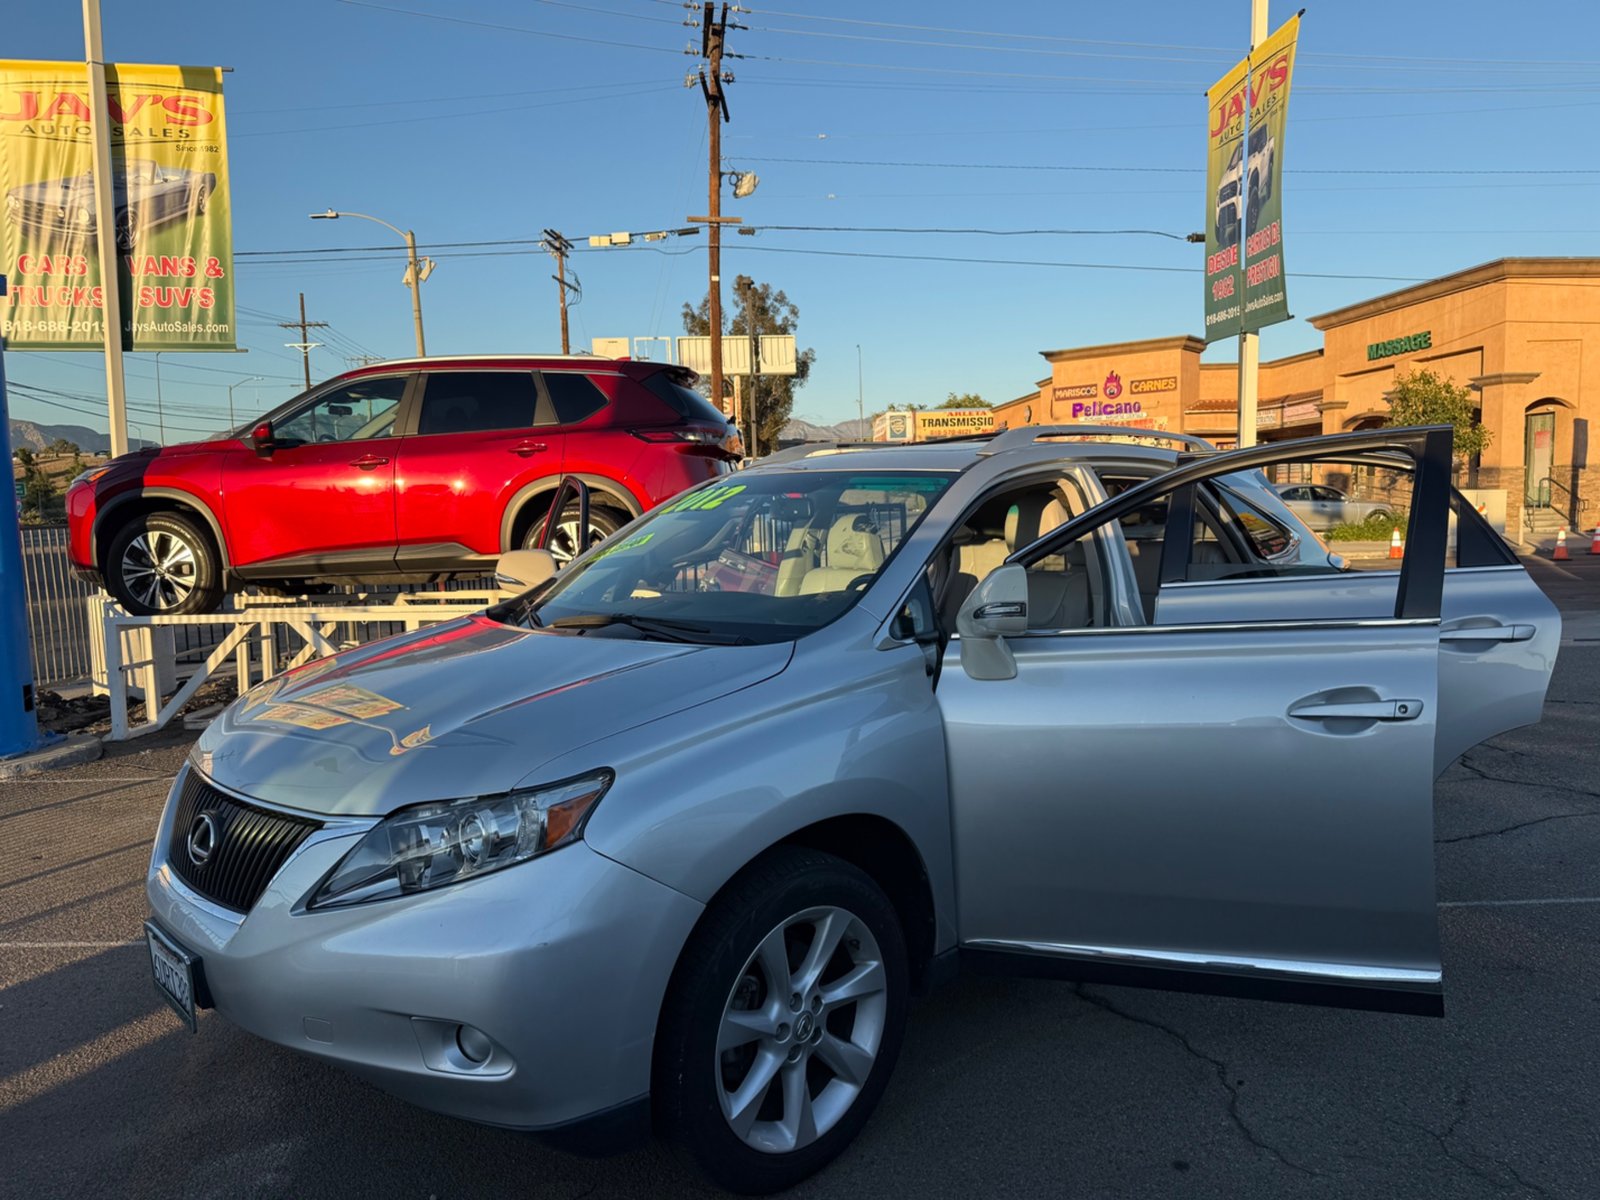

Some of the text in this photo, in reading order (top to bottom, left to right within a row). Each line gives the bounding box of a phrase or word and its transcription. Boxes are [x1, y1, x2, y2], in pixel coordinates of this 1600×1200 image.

[20, 124, 191, 139] AUTO SALES
[17, 254, 225, 279] CARS VANS &
[1207, 243, 1238, 276] DESDE
[7, 285, 216, 308] TRUCKS SUV'S
[1367, 330, 1433, 361] MASSAGE
[1054, 378, 1176, 399] MARISCOS CARNES
[1072, 400, 1141, 418] Pelicano
[921, 416, 994, 428] TRANSMISSIO
